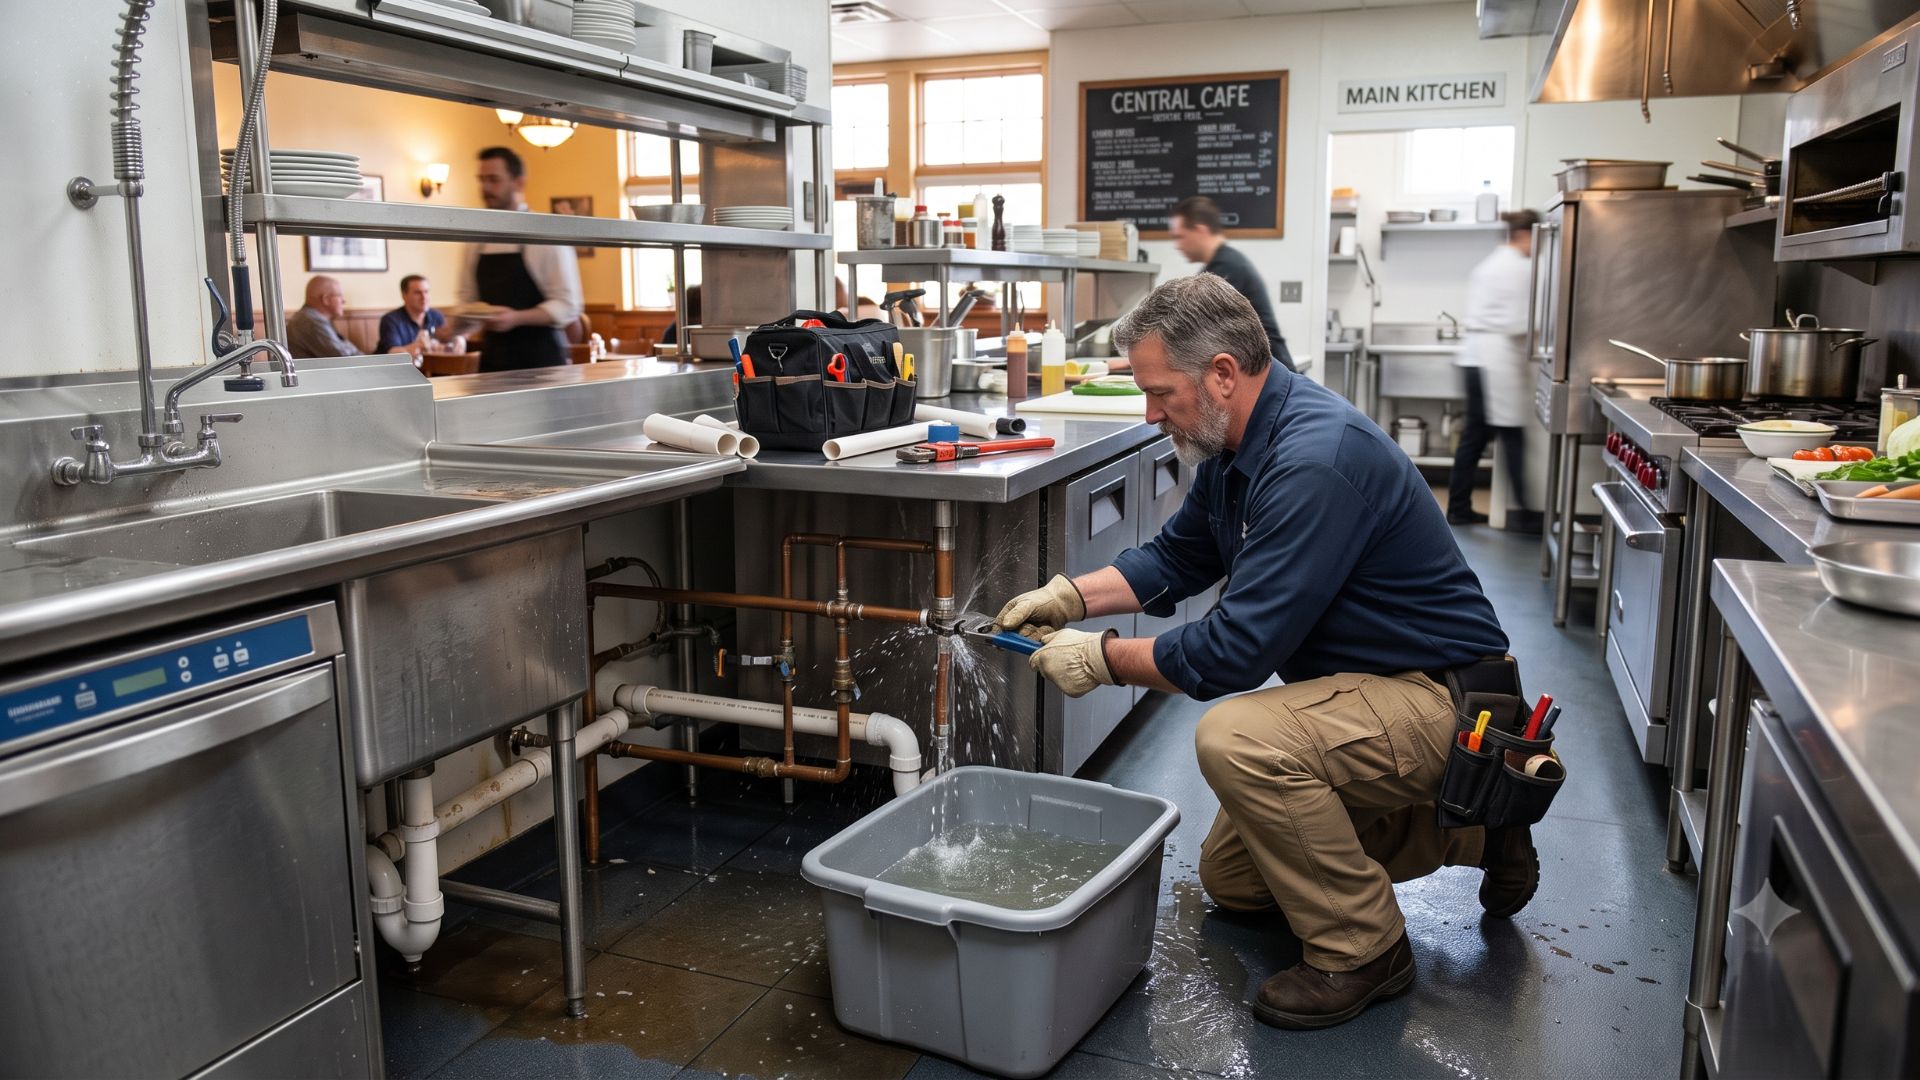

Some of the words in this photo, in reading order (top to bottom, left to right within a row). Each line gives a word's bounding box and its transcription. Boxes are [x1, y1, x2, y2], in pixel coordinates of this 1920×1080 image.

[1111, 88, 1196, 114] CENTRAL
[1200, 84, 1251, 109] CAFE
[1346, 86, 1400, 105] MAIN
[1406, 80, 1496, 102] KITCHEN
